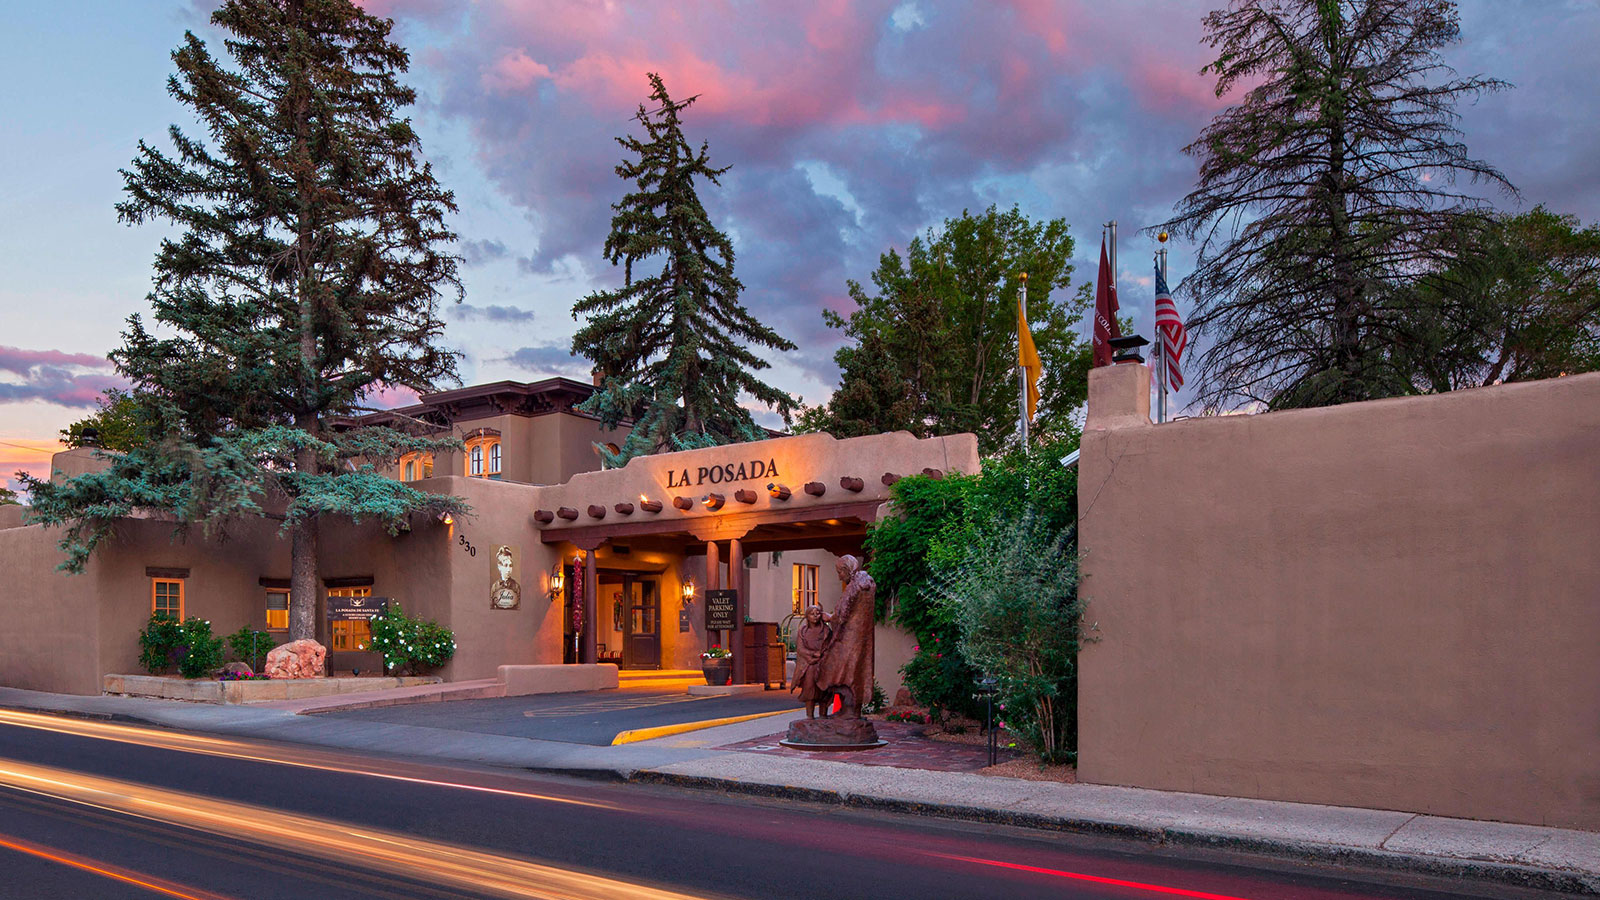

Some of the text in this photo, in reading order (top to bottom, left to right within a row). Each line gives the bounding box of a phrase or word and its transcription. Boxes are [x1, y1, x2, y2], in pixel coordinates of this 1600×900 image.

[667, 458, 779, 488] LA POSADA
[459, 535, 476, 556] 330
